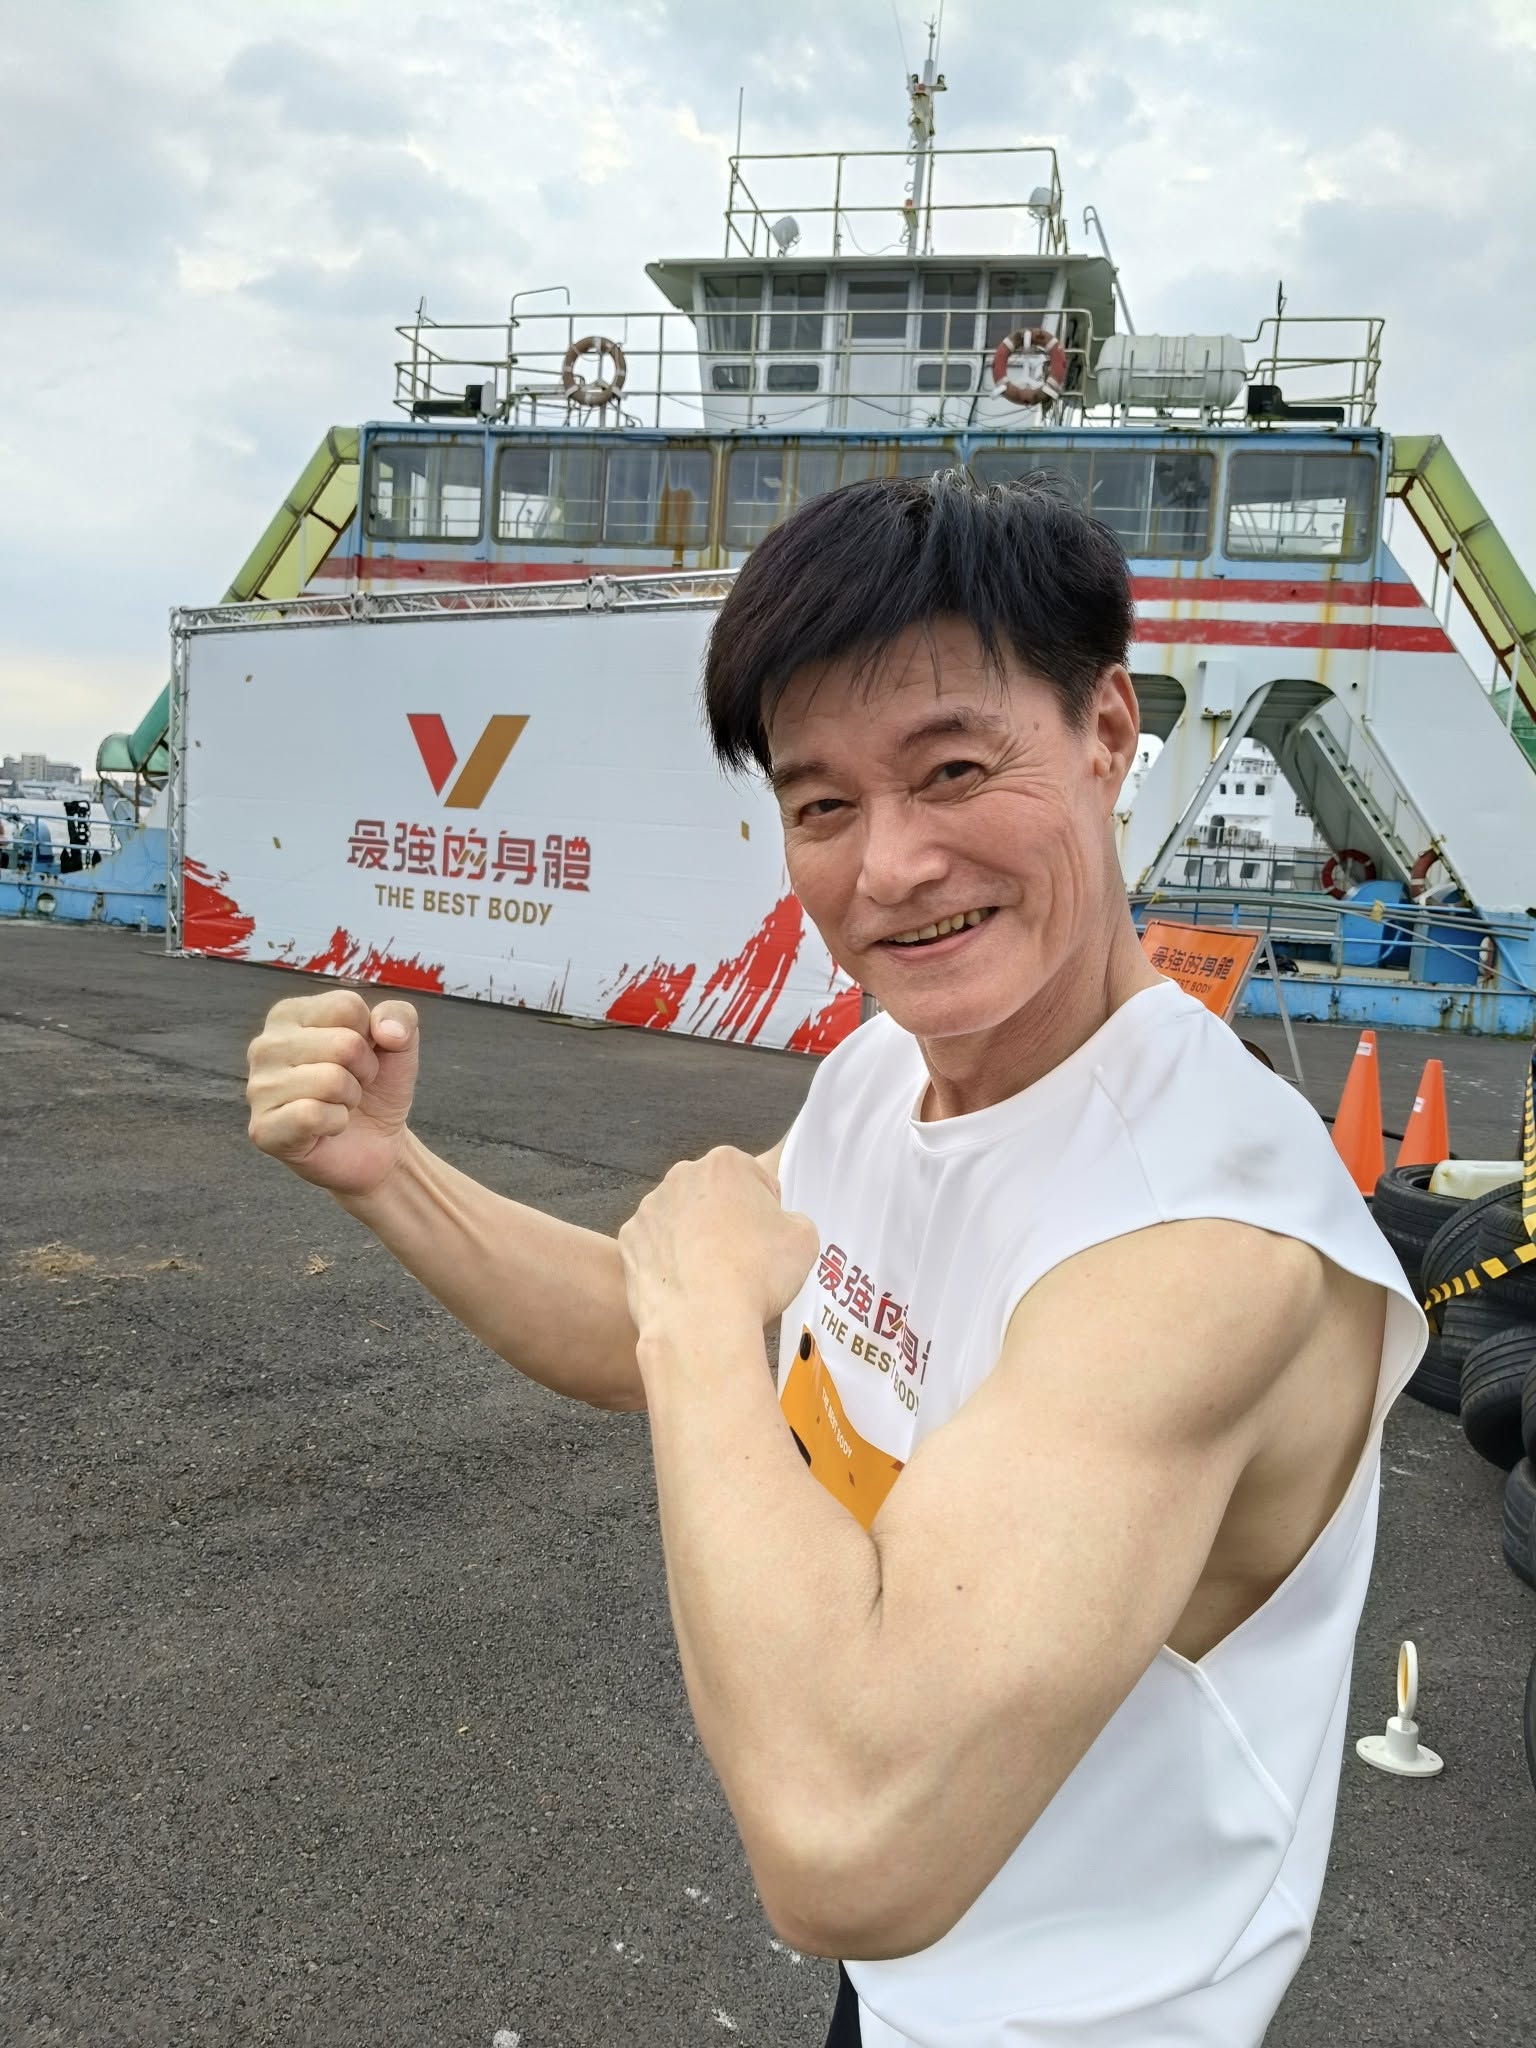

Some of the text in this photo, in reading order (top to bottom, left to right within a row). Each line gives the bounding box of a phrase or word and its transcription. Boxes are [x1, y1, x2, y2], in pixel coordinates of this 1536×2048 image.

[347, 819, 591, 892] 最強的身體
[374, 884, 553, 926] THE BEST BODY
[1150, 945, 1234, 980] 最強的身體
[1190, 981, 1212, 994] BODY
[821, 1304, 849, 1345] THE
